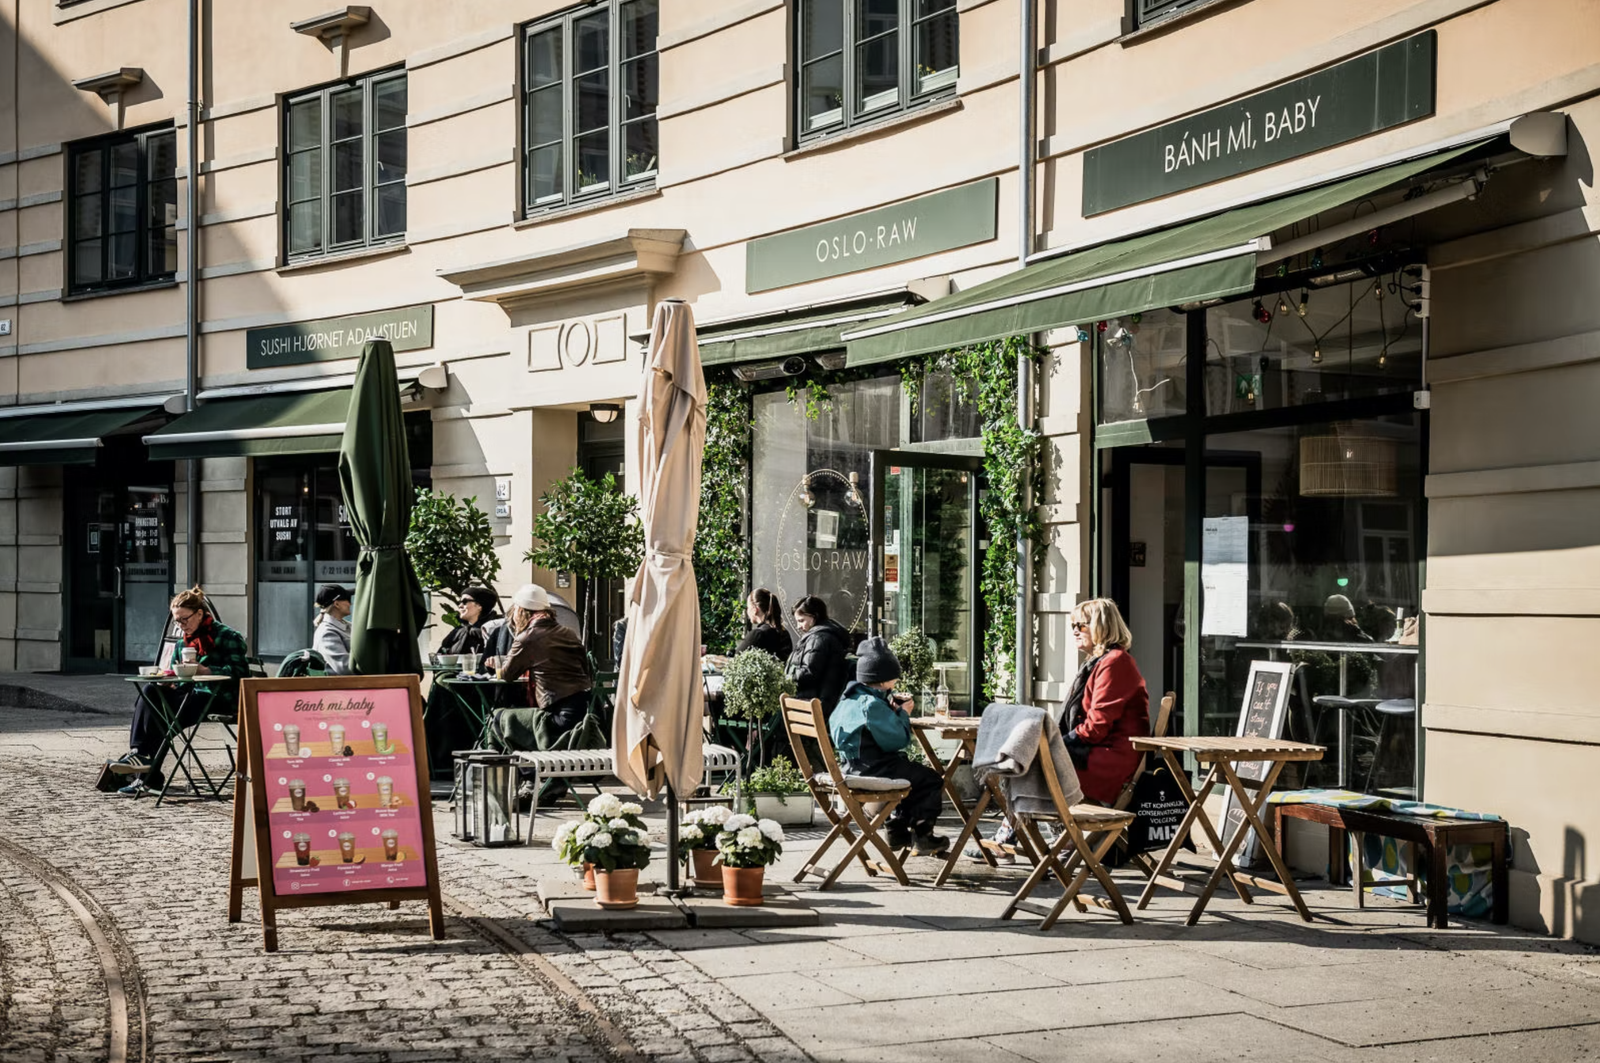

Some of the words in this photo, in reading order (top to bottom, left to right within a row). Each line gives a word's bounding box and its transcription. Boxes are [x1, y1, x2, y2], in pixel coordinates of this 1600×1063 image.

[1164, 130, 1220, 173] BÁNH
[1226, 112, 1257, 155] MÌ,
[1264, 95, 1322, 143] BABY
[260, 337, 290, 356] SUSHI
[293, 330, 344, 352] HJØRNET
[347, 320, 417, 347] ADAMSTUEN
[275, 506, 292, 516] STORT
[270, 518, 290, 528] UTVALG
[290, 518, 298, 528] AV
[276, 531, 292, 540] SUSHI
[294, 698, 325, 712] Bánh
[1150, 816, 1177, 824] VOLGENS
